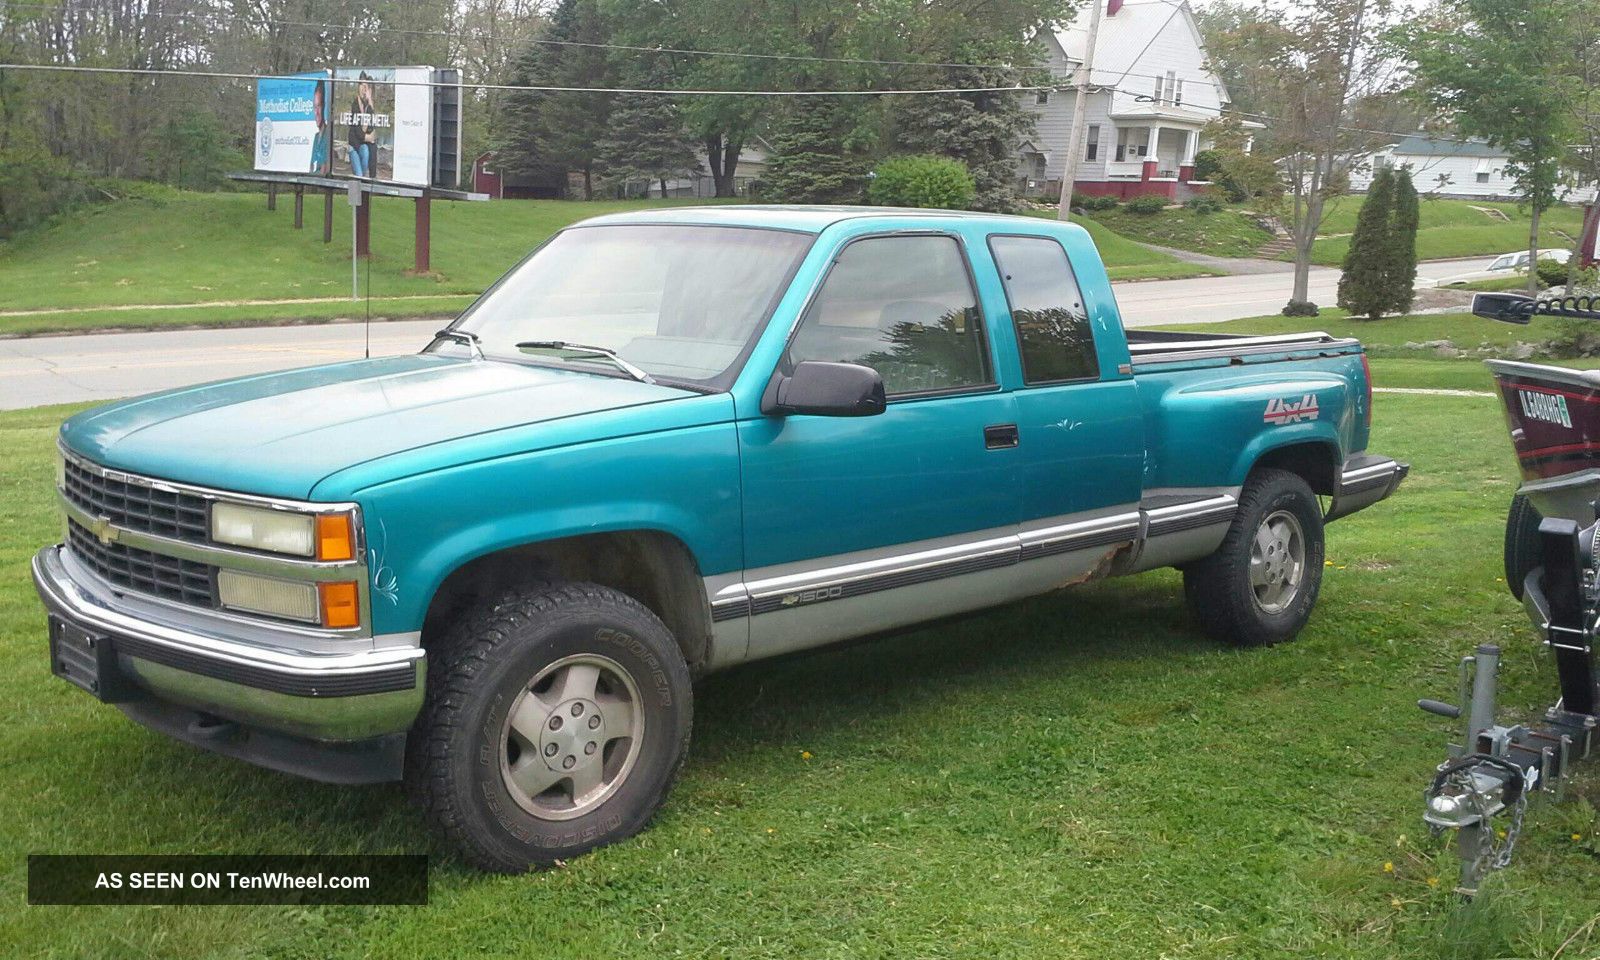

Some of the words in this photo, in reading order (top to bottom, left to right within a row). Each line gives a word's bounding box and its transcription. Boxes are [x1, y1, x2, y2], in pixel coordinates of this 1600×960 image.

[259, 98, 289, 113] Methodist
[290, 97, 313, 115] College
[340, 112, 353, 126] LIFE
[353, 113, 372, 126] AFTER
[372, 113, 391, 128] METH.
[1263, 393, 1319, 425] 4x4
[799, 586, 842, 603] 1500
[594, 628, 673, 708] COOPER
[481, 782, 623, 848] DISCOVERER
